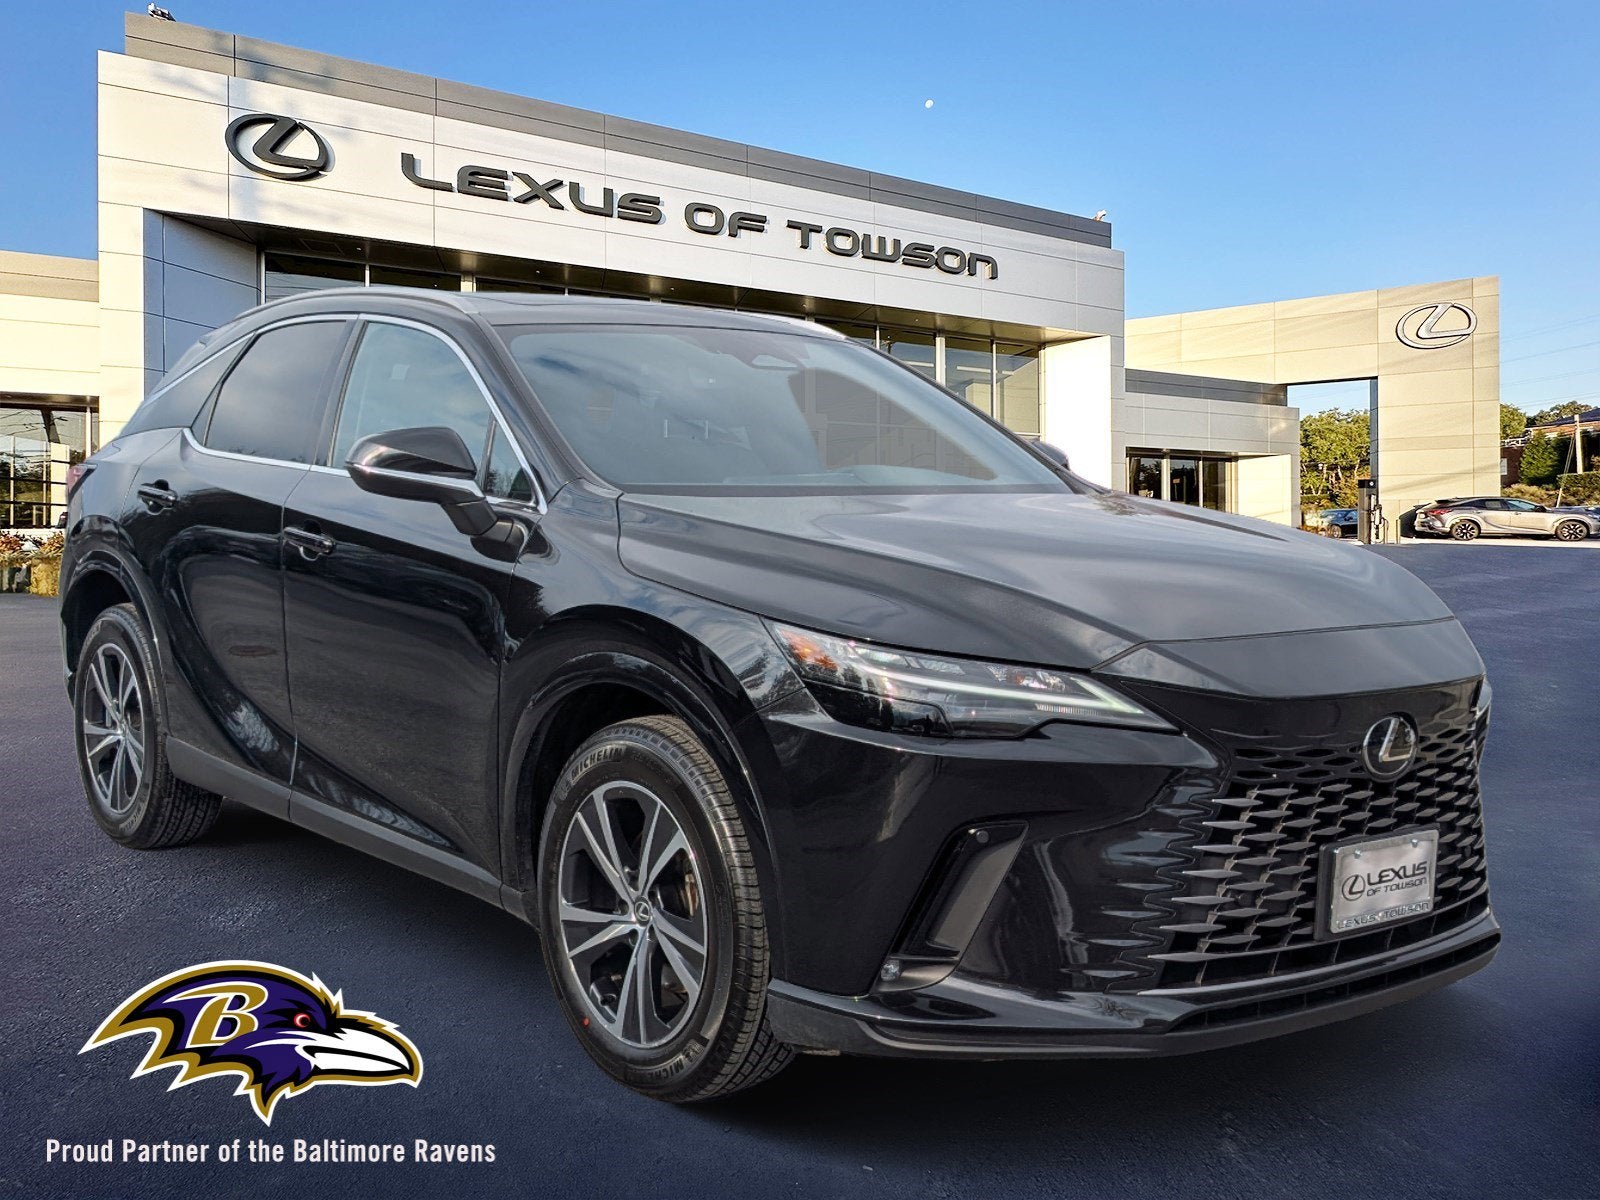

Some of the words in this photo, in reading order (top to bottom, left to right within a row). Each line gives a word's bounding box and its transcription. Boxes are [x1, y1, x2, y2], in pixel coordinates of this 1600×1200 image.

[401, 152, 664, 224] LEXUS
[684, 202, 767, 238] OF
[787, 219, 999, 280] TOWSON
[571, 747, 624, 780] MICHELIN
[1366, 887, 1381, 897] OF
[1384, 877, 1428, 892] TOWSON
[1367, 861, 1428, 886] LEXUS
[1337, 913, 1376, 929] LEXUS
[1384, 902, 1429, 919] TOWSON
